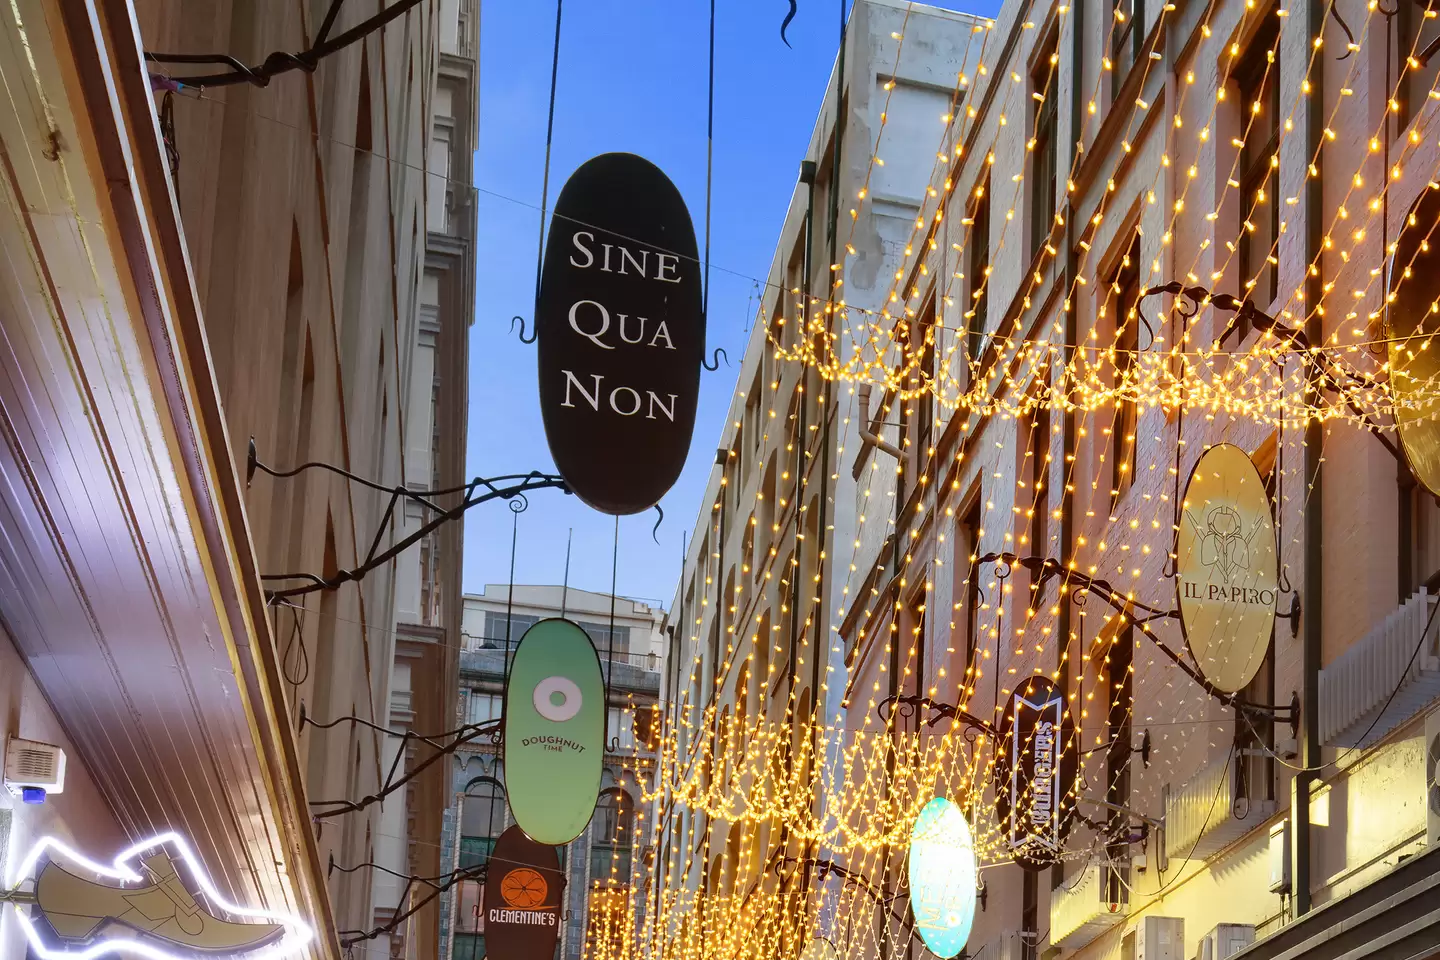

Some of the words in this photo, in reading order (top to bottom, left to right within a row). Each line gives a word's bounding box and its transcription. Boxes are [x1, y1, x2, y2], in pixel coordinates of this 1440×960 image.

[569, 231, 682, 284] SINE
[568, 299, 677, 350] QUA
[560, 369, 679, 422] NON
[1184, 582, 1202, 599] IL
[1208, 584, 1275, 606] PAPIRO
[521, 735, 586, 753] DOUGHNUT
[543, 744, 563, 752] TIME
[489, 908, 556, 926] CLEMENTINE'S
